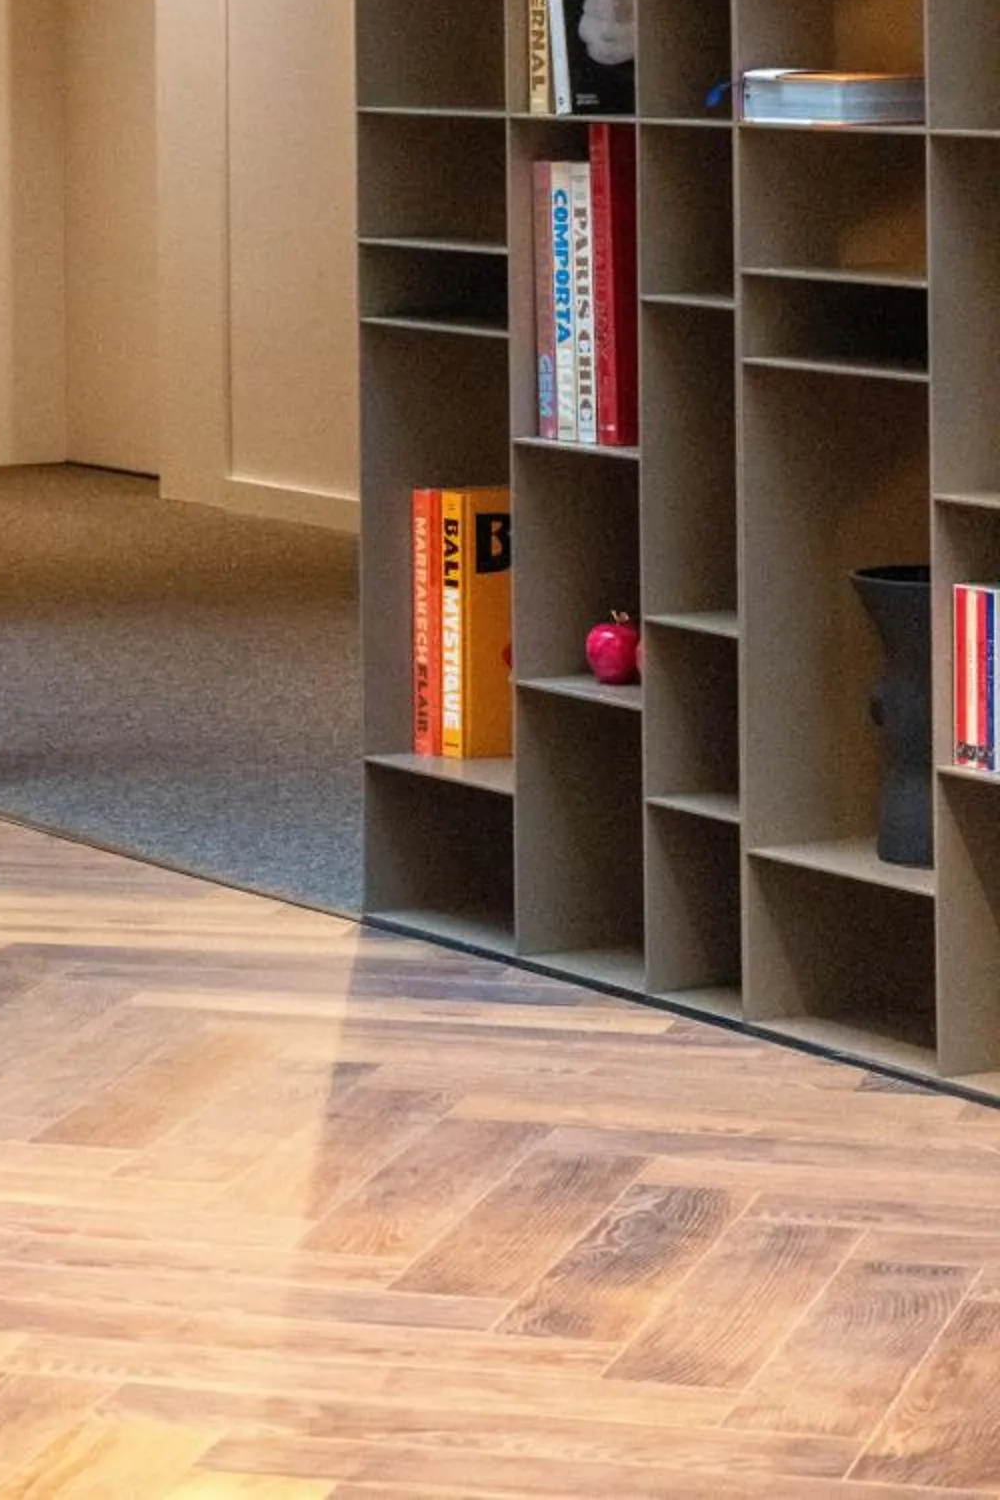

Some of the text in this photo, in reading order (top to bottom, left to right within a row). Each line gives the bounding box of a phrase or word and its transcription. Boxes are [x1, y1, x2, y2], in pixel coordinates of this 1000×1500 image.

[553, 189, 572, 343] COMPORTA
[573, 207, 593, 422] PARIS CHIC
[414, 516, 429, 733] MARRAKECH FLAIR
[443, 517, 461, 729] BALI MYSTIQUE
